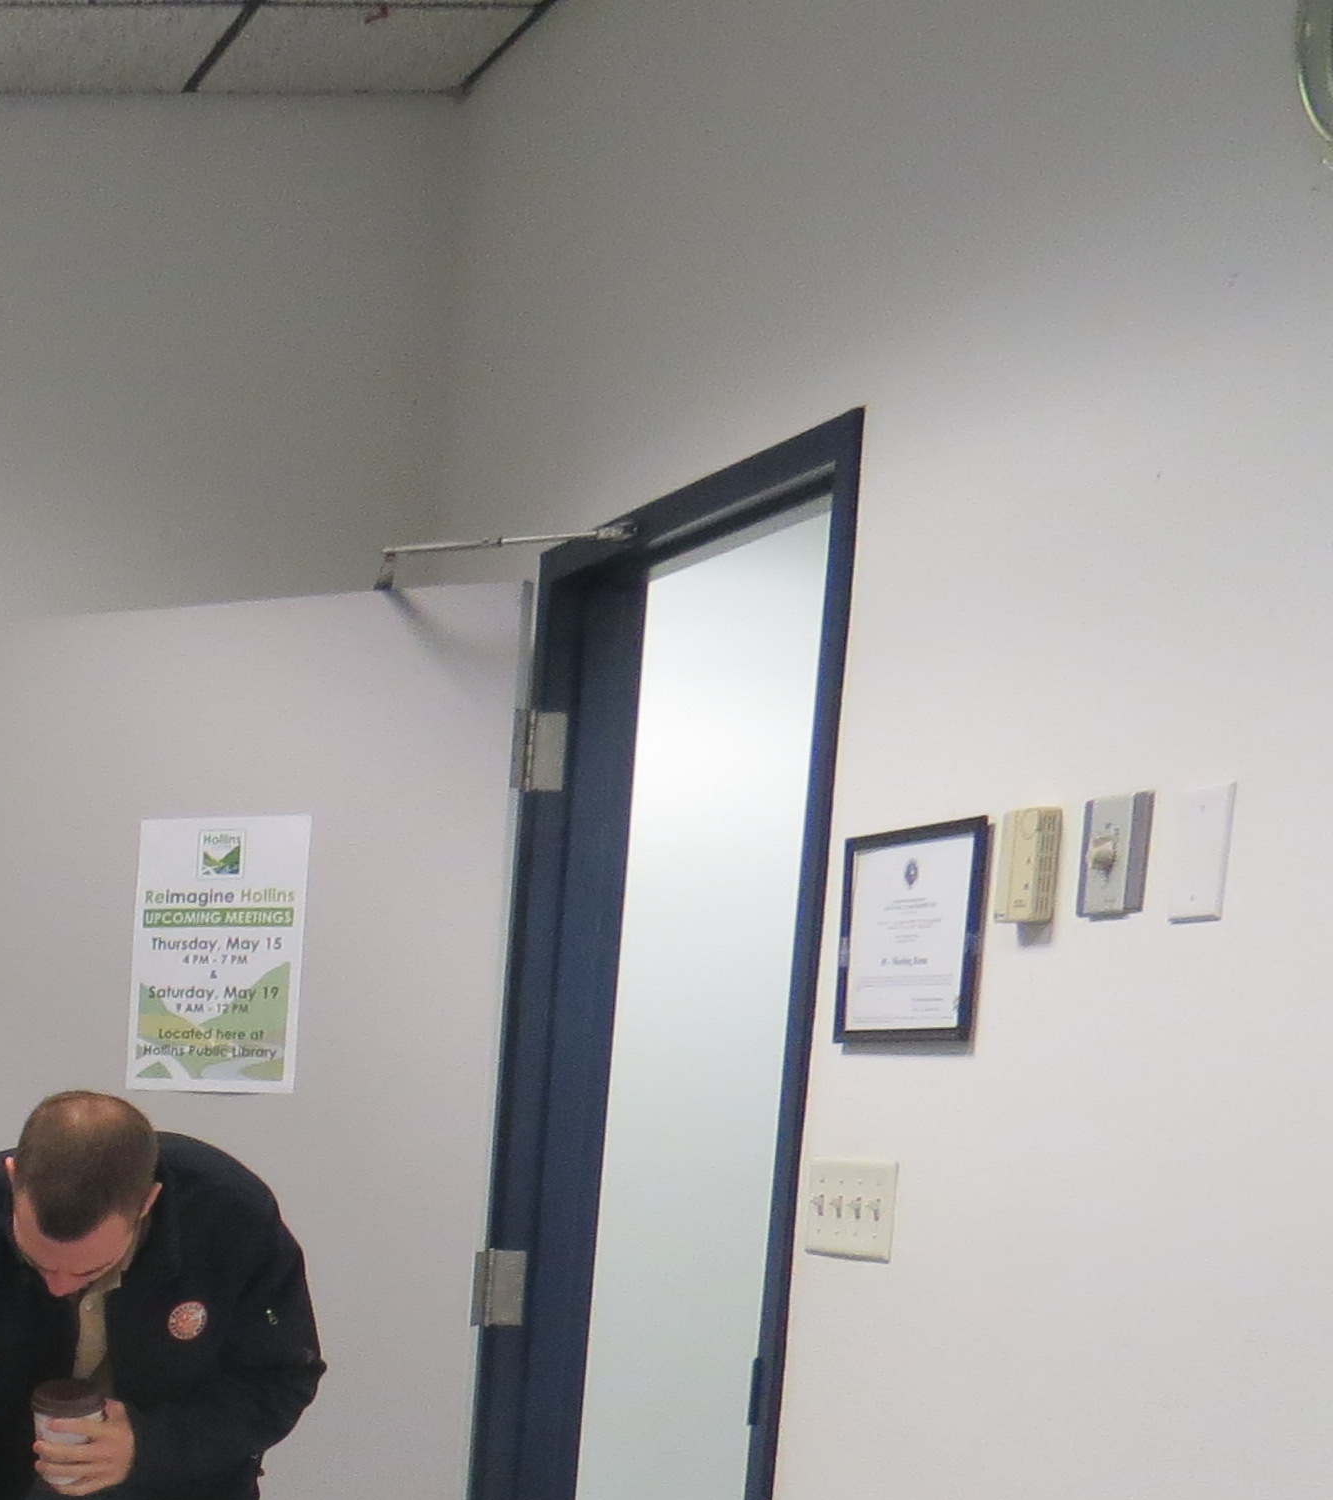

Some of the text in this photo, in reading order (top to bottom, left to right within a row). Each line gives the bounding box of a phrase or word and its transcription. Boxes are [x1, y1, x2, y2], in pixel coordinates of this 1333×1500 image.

[202, 834, 241, 845] Hollins
[145, 888, 295, 906] Reimagine Hollins
[145, 910, 293, 924] UPCOMING MEETINGS
[151, 937, 283, 952] Thursday, May 15
[182, 955, 190, 965] 4
[192, 955, 210, 965] PM
[221, 955, 228, 964] 7
[230, 954, 248, 965] PM
[210, 969, 218, 979] &
[148, 985, 279, 1001] Saturday, May 19
[175, 1003, 182, 1013] 9
[184, 1003, 205, 1014] AM
[216, 1003, 229, 1013] 12
[231, 1003, 249, 1014] PM
[158, 1028, 265, 1041] Located here at
[143, 1044, 278, 1060] Hollins Public Library
